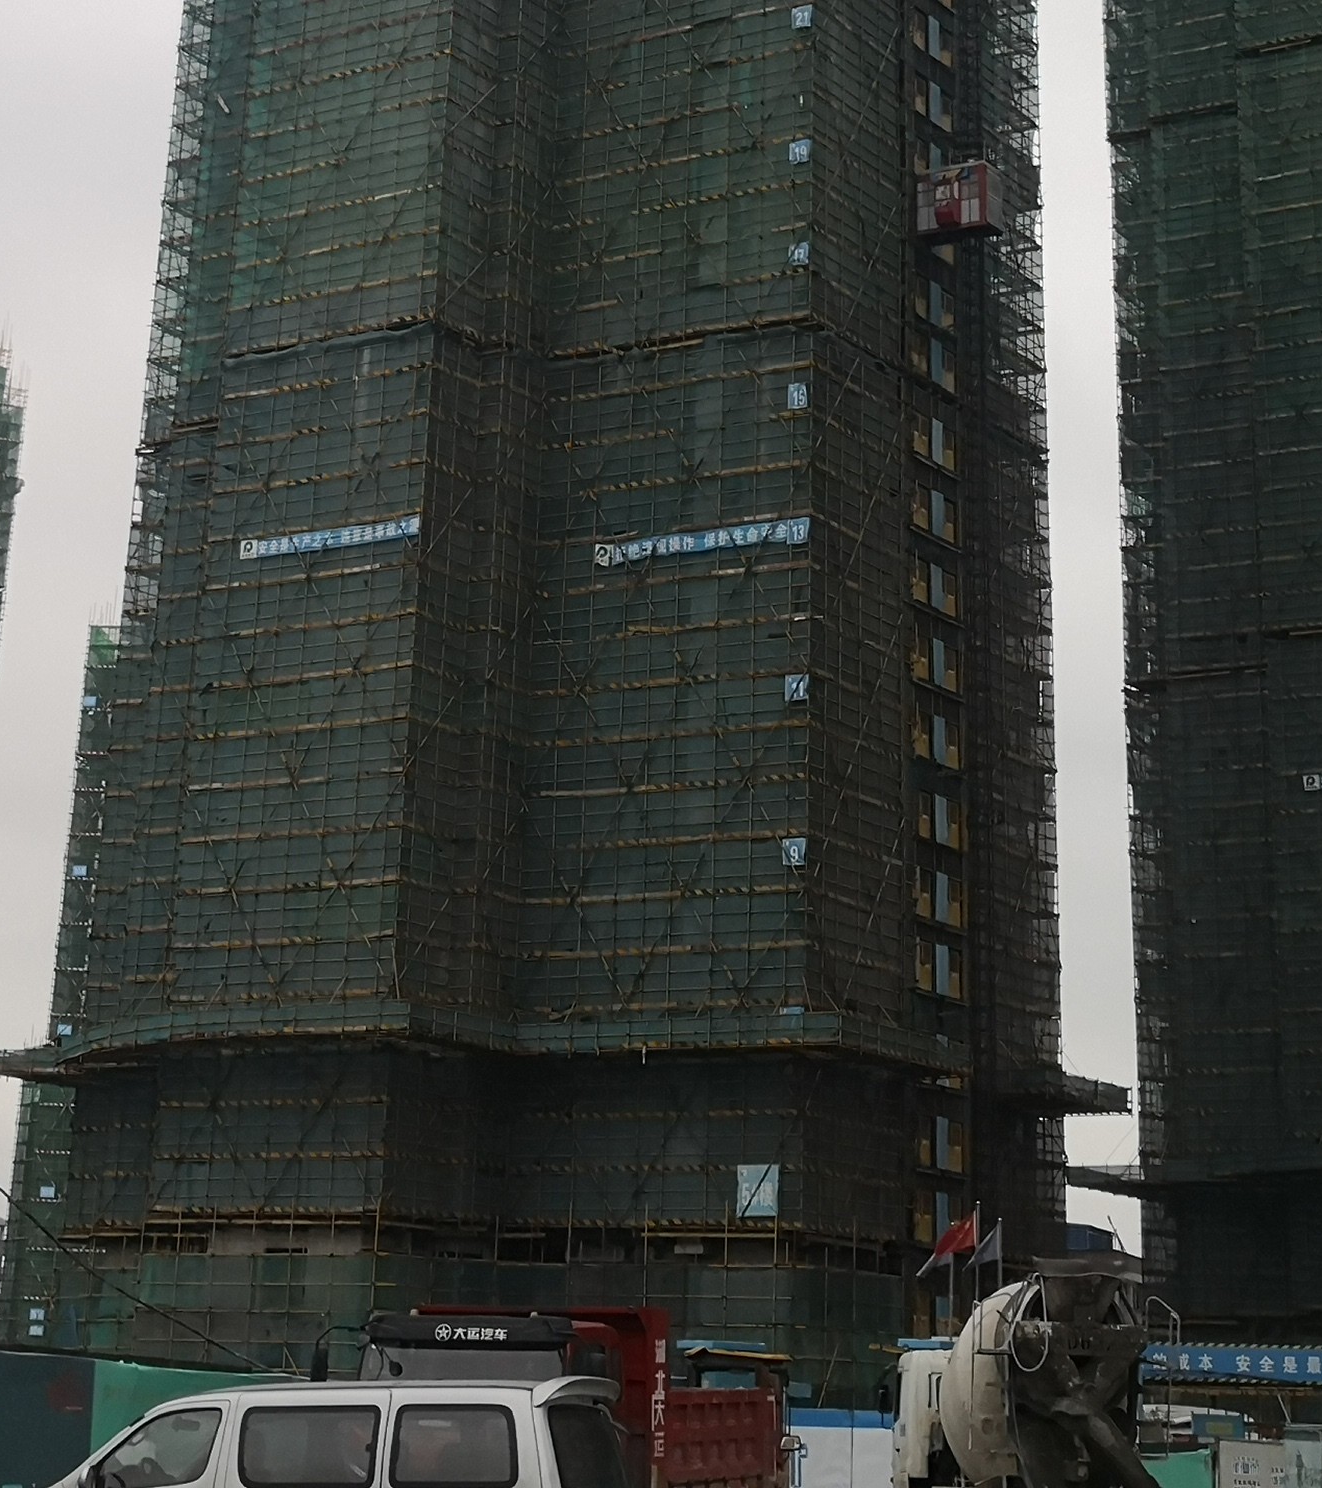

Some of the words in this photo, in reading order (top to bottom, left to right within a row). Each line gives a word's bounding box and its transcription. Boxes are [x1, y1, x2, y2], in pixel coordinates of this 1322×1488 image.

[795, 11, 809, 26] 21
[794, 145, 807, 161] 19
[792, 388, 805, 406] 15
[792, 524, 805, 541] 13
[790, 845, 799, 862] 9
[453, 1327, 508, 1341] 大运汽车
